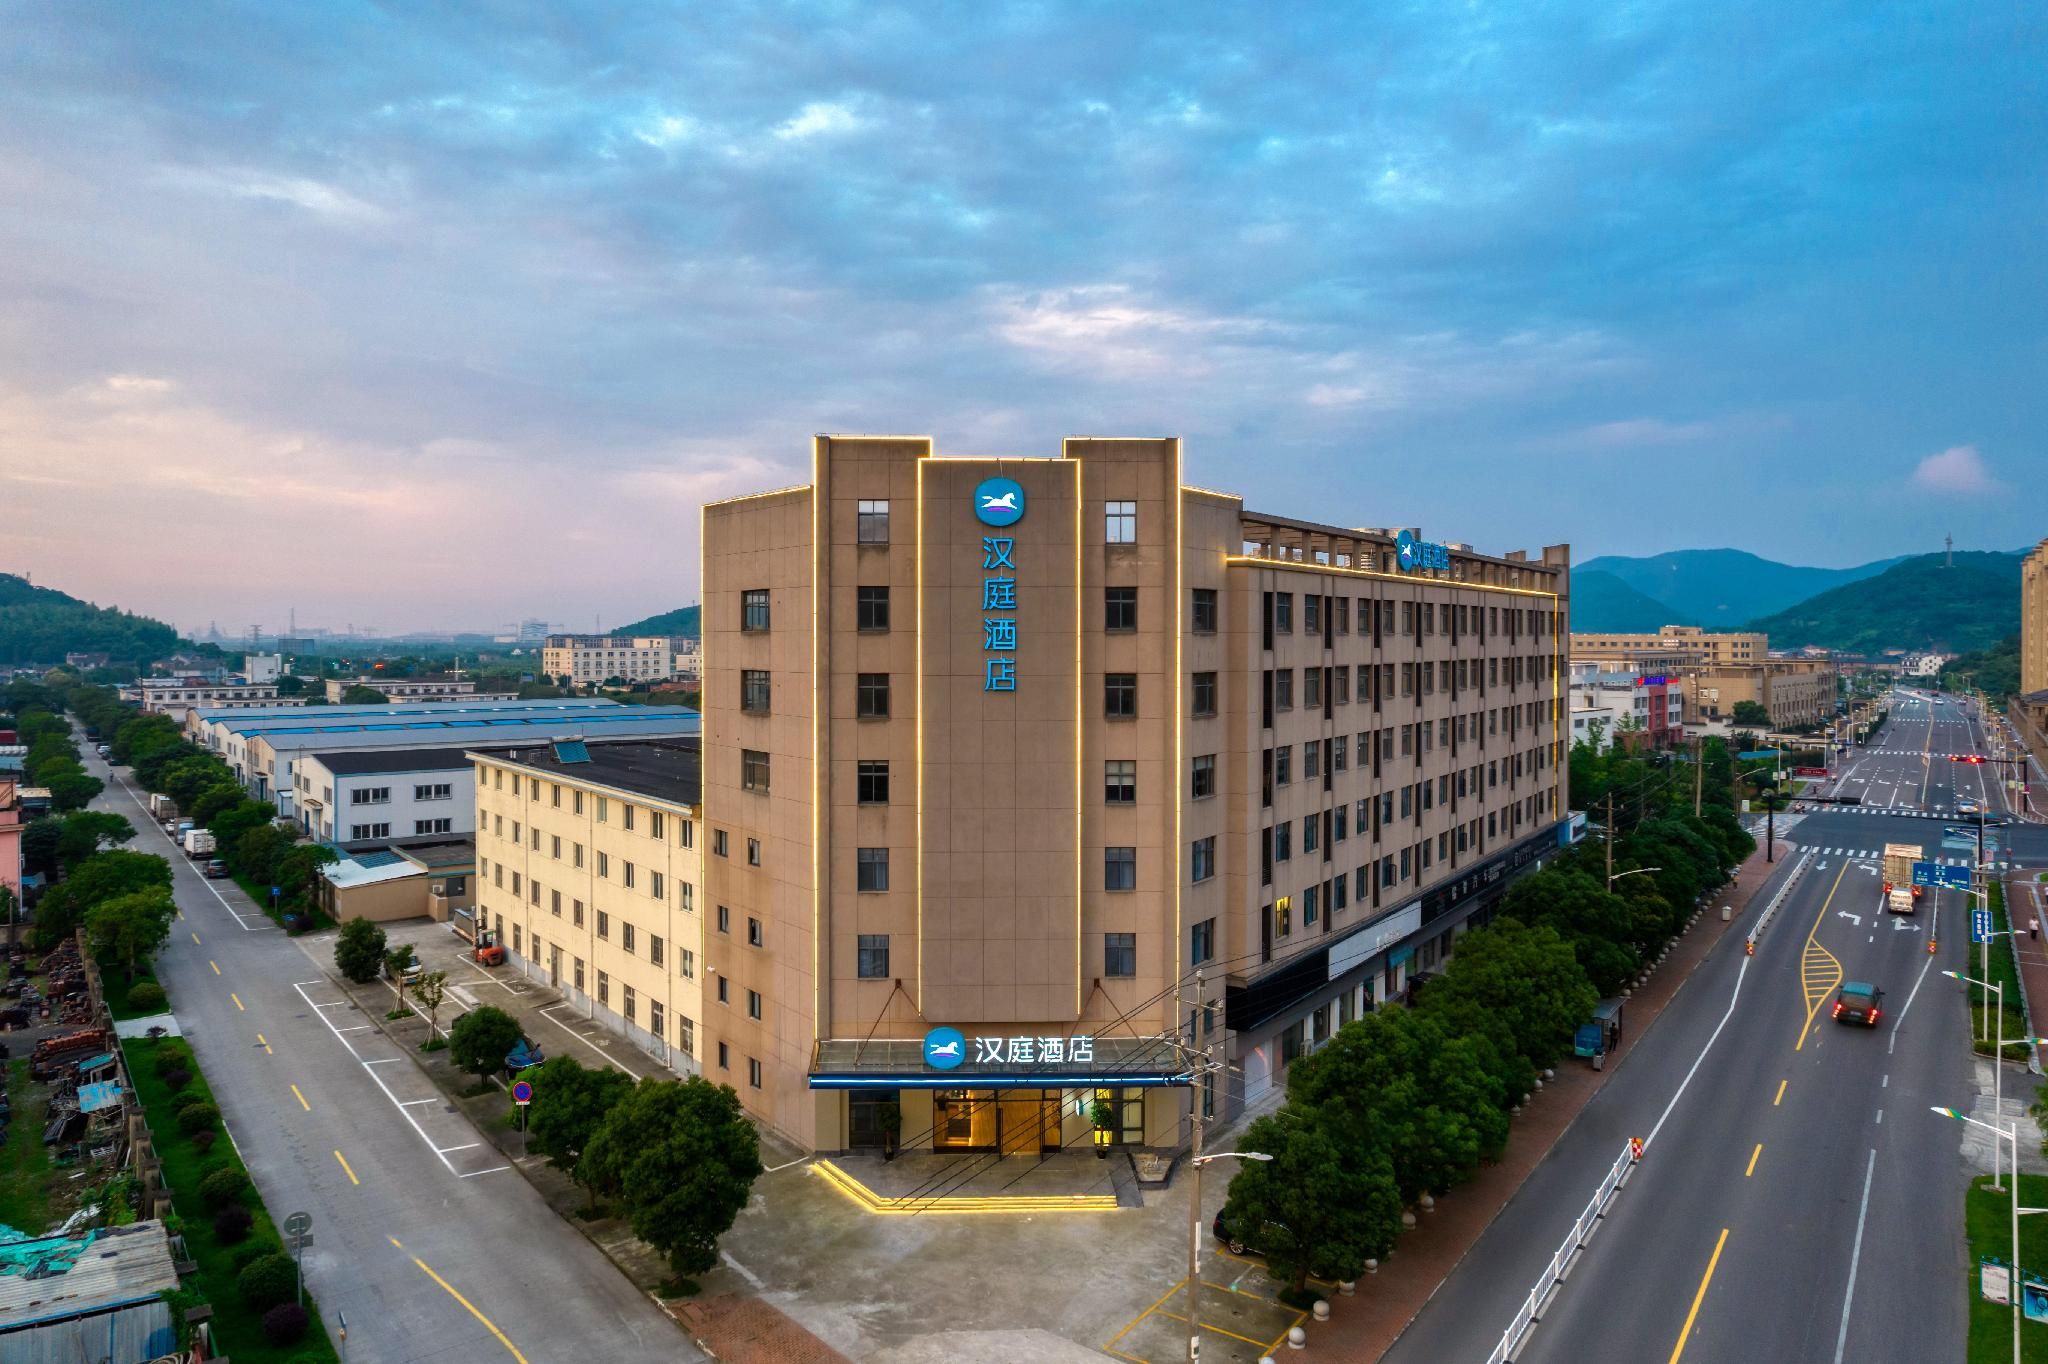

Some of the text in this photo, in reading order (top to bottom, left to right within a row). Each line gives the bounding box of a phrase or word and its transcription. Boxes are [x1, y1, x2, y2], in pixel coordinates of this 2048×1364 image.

[982, 536, 1017, 692] 汉庭酒店
[975, 1035, 1094, 1064] 汉庭酒店
